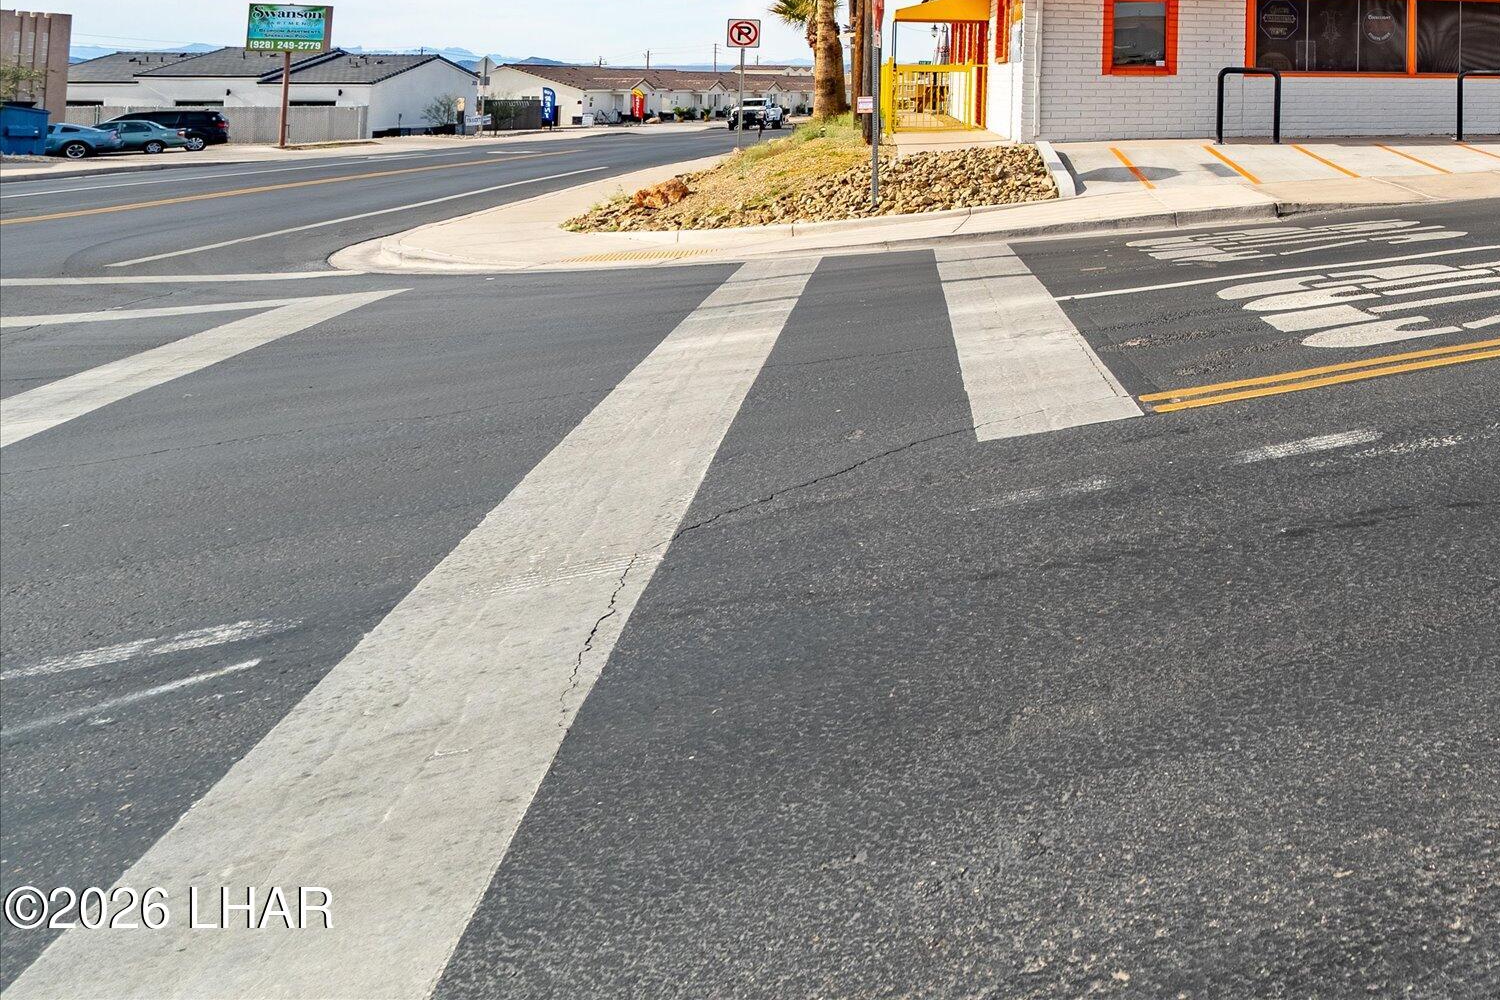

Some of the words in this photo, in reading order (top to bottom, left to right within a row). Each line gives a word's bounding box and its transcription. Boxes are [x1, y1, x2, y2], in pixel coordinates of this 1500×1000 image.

[252, 5, 322, 19] Swanson
[250, 40, 274, 49] (928)
[277, 41, 321, 50] 249-2779
